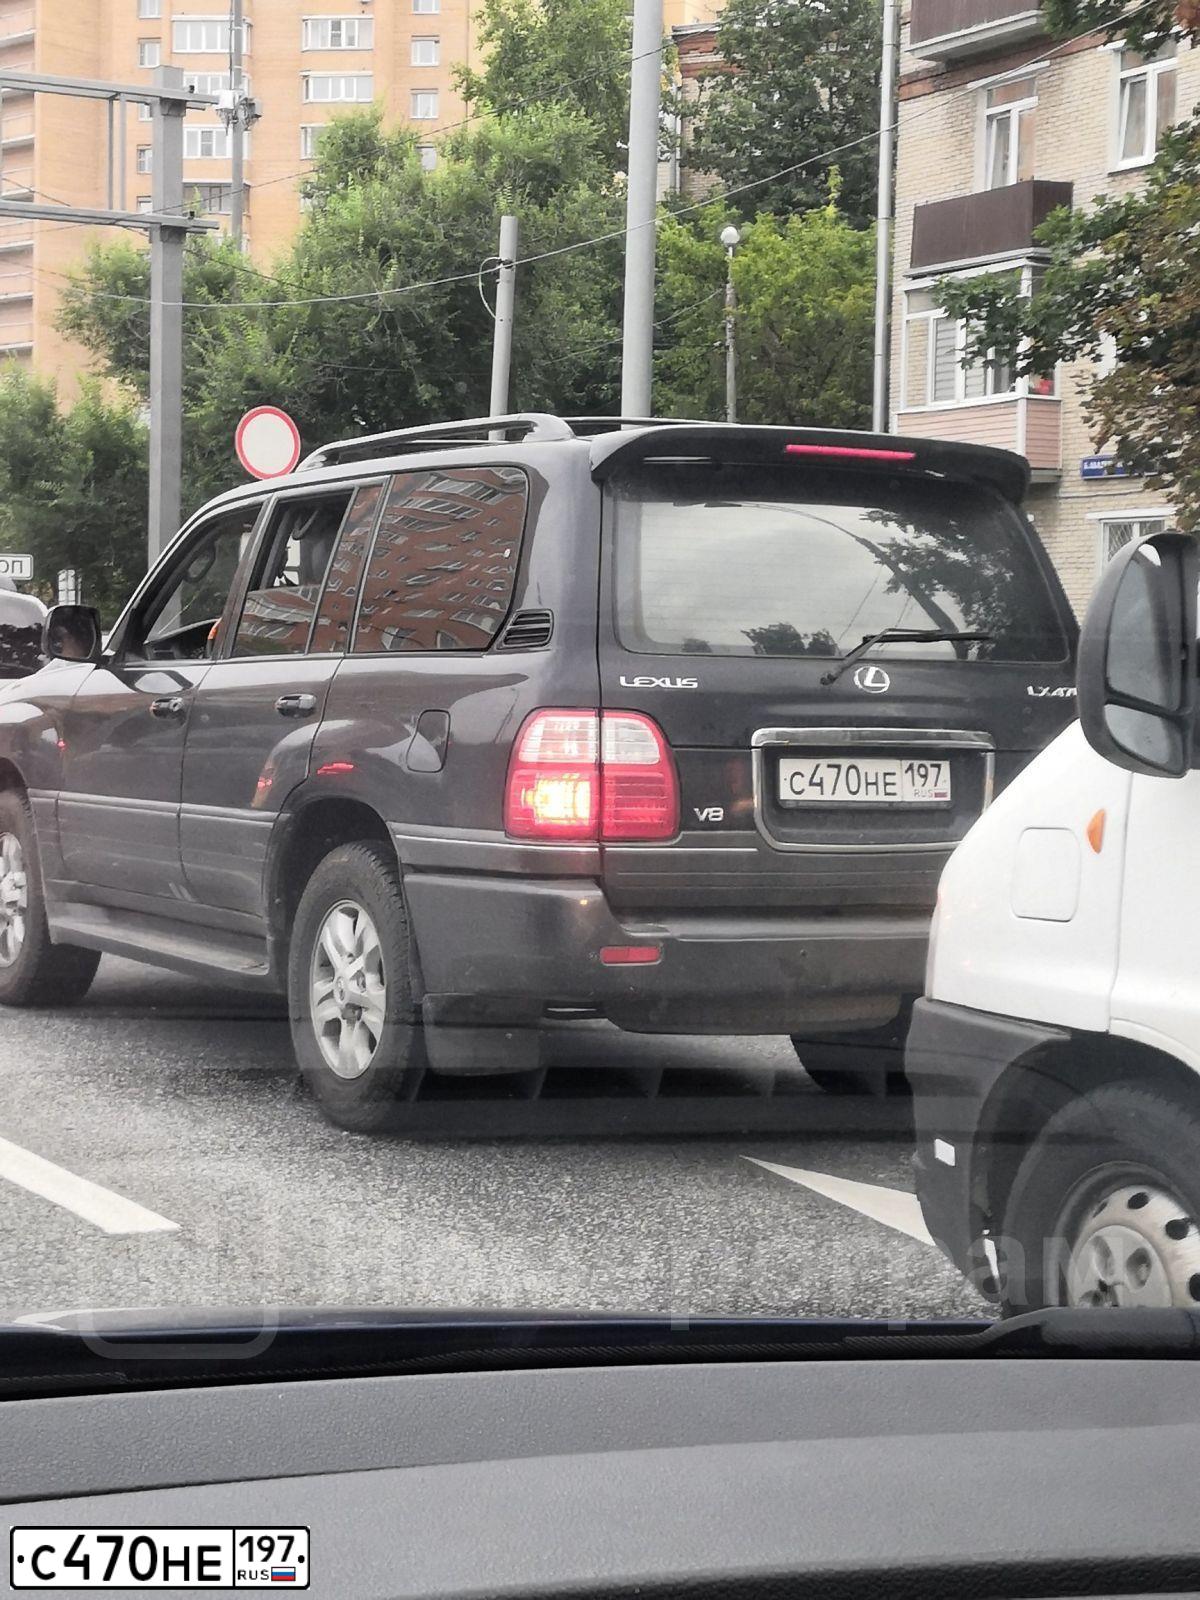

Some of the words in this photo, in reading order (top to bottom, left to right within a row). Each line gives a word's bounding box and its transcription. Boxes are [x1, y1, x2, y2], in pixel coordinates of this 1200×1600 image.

[620, 676, 698, 688] LEXUS
[904, 762, 942, 788] 197
[914, 789, 934, 798] RUS
[693, 807, 724, 821] V8
